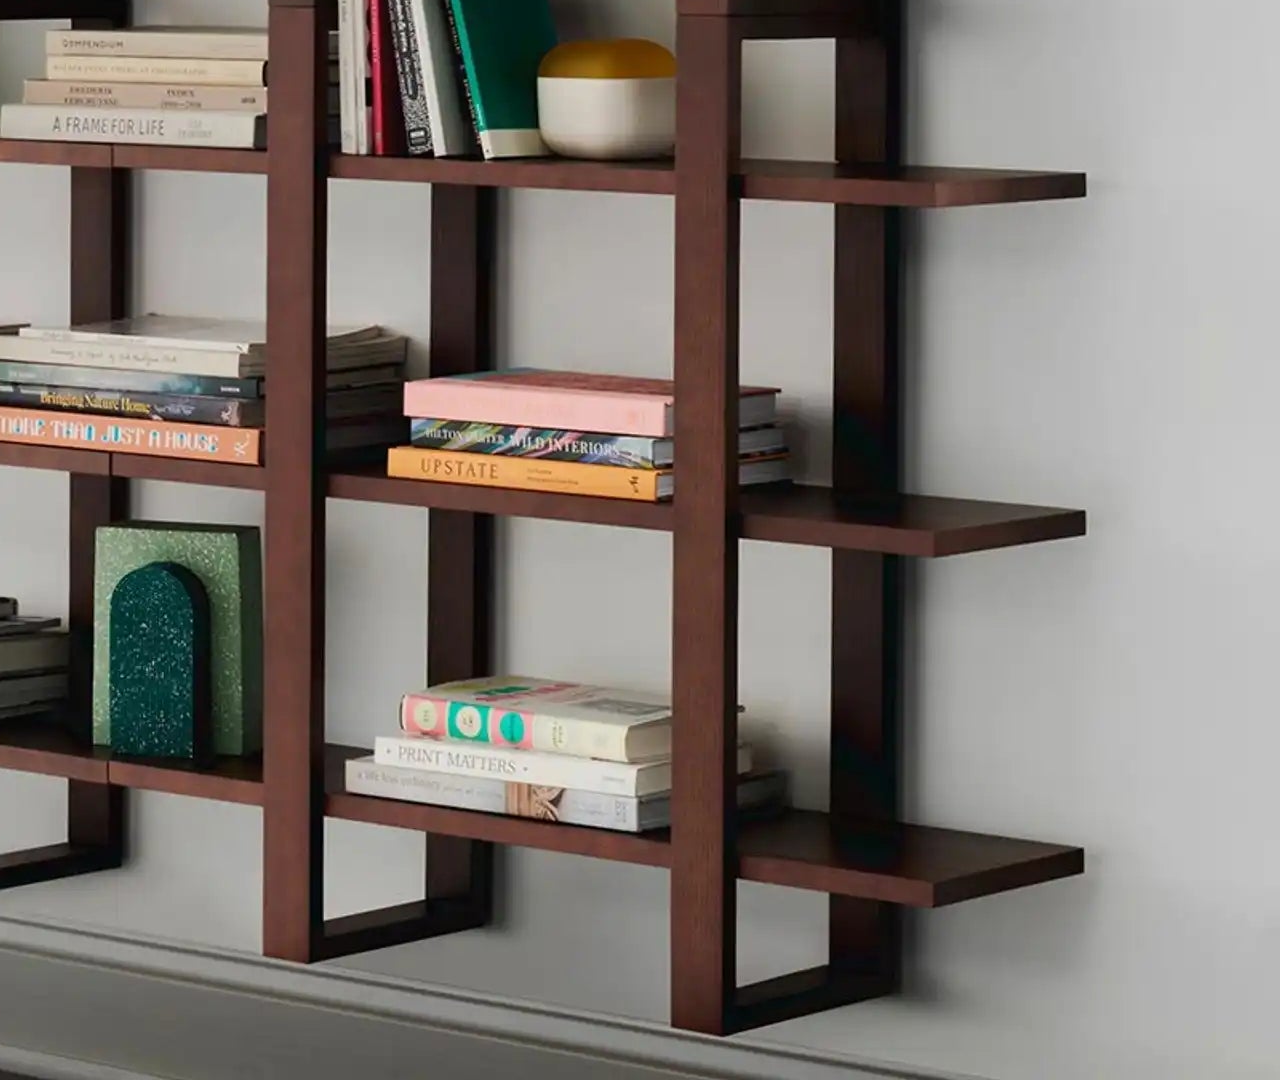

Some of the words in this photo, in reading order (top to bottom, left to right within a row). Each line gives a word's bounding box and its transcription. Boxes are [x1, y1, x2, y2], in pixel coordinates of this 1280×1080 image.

[52, 116, 62, 132] A
[66, 117, 107, 134] FRAME
[111, 119, 133, 135] FOR
[139, 119, 165, 136] LIFE
[41, 391, 84, 410] Bringing
[50, 420, 95, 441] THAN
[102, 424, 145, 445] JUST
[165, 432, 219, 453] HOUSE
[510, 435, 546, 450] WILD
[549, 438, 620, 458] INTERIORS
[421, 458, 499, 479] UPSTATE
[398, 745, 443, 766] PRINT
[446, 751, 517, 775] MATTERS
